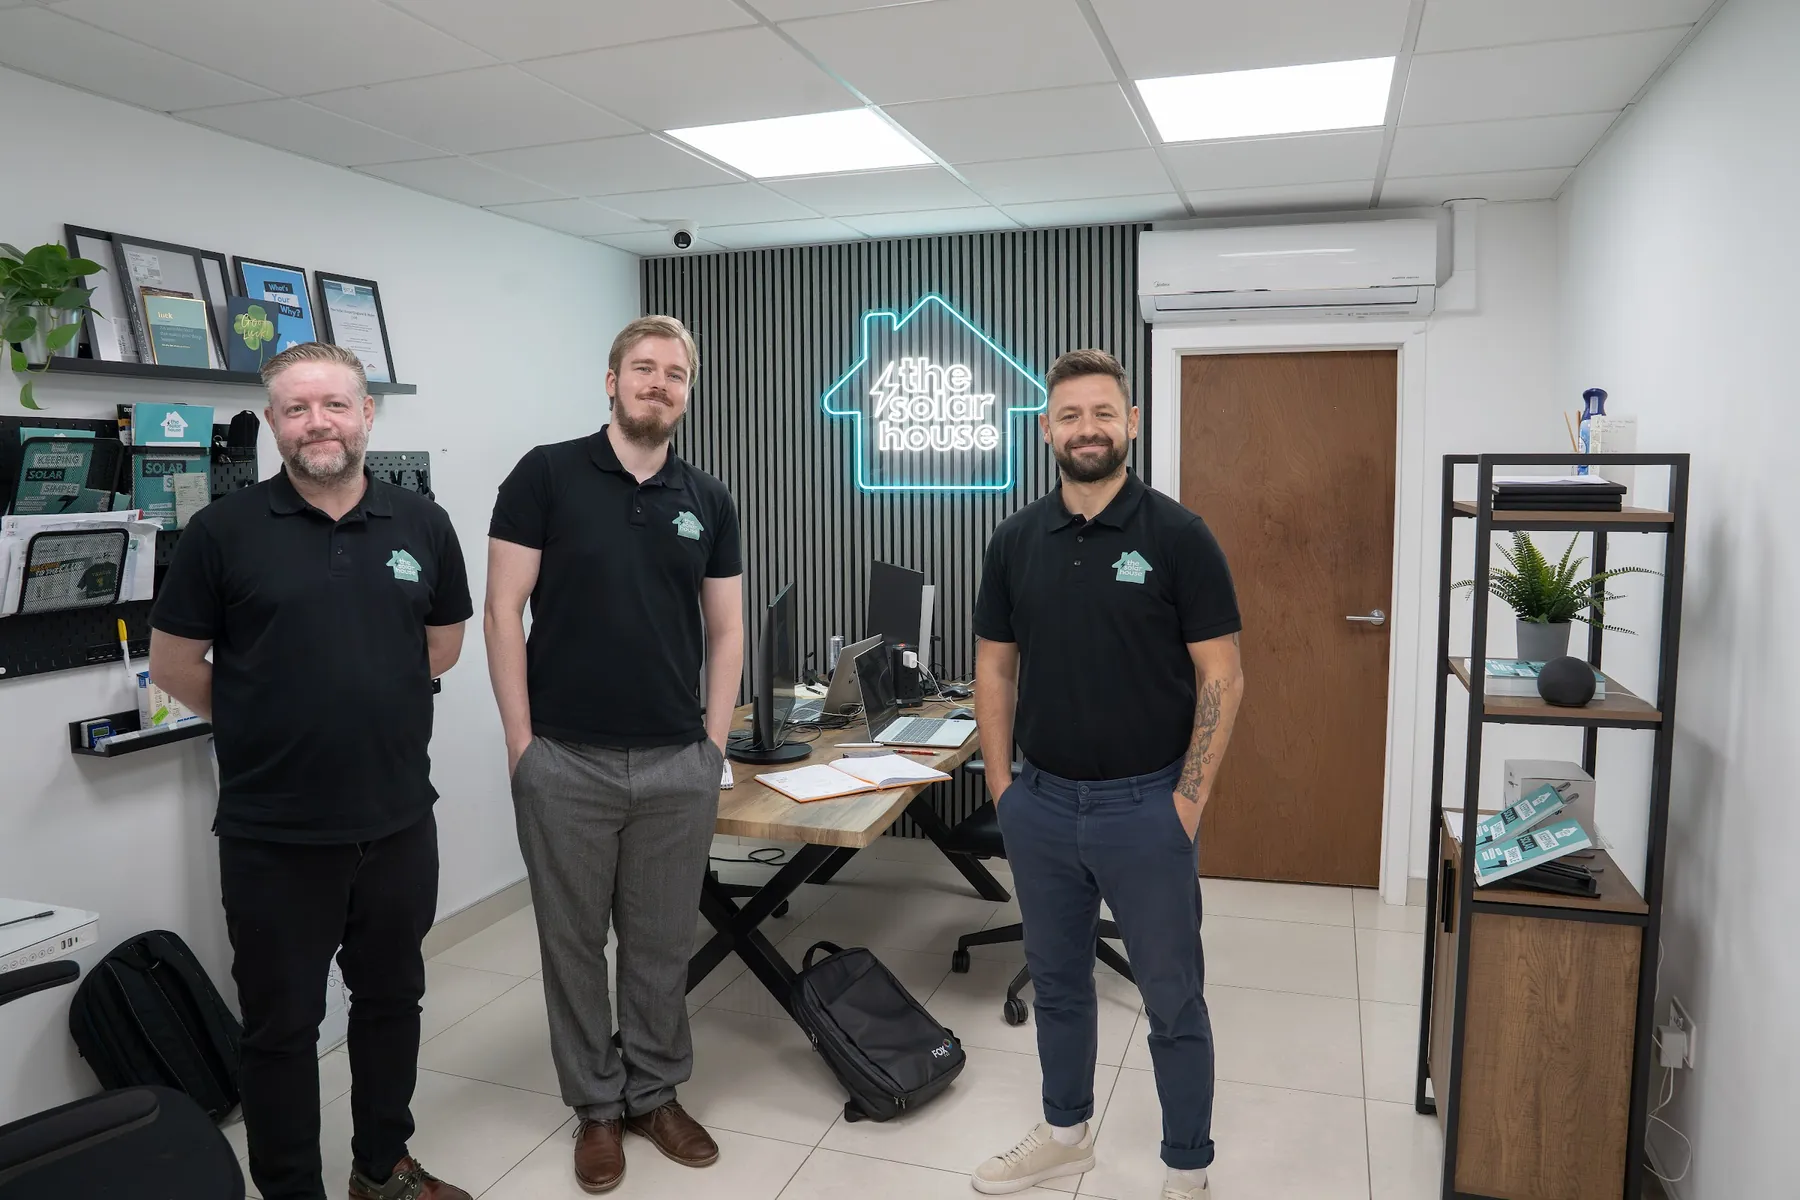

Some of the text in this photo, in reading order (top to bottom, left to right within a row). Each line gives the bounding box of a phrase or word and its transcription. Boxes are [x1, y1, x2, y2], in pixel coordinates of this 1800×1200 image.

[268, 283, 289, 292] What's
[271, 293, 290, 303] Your
[157, 311, 174, 320] luck
[280, 304, 301, 317] Why?
[241, 313, 267, 328] Good
[898, 356, 972, 393] the
[887, 389, 996, 422] solar
[879, 420, 1000, 452] house
[145, 462, 184, 474] SOLAR
[27, 470, 63, 479] SOLAR
[43, 484, 78, 493] SIMPLE
[1123, 564, 1143, 572] solar
[1127, 559, 1140, 567] the
[1119, 569, 1143, 577] house
[931, 1045, 948, 1059] FOX
